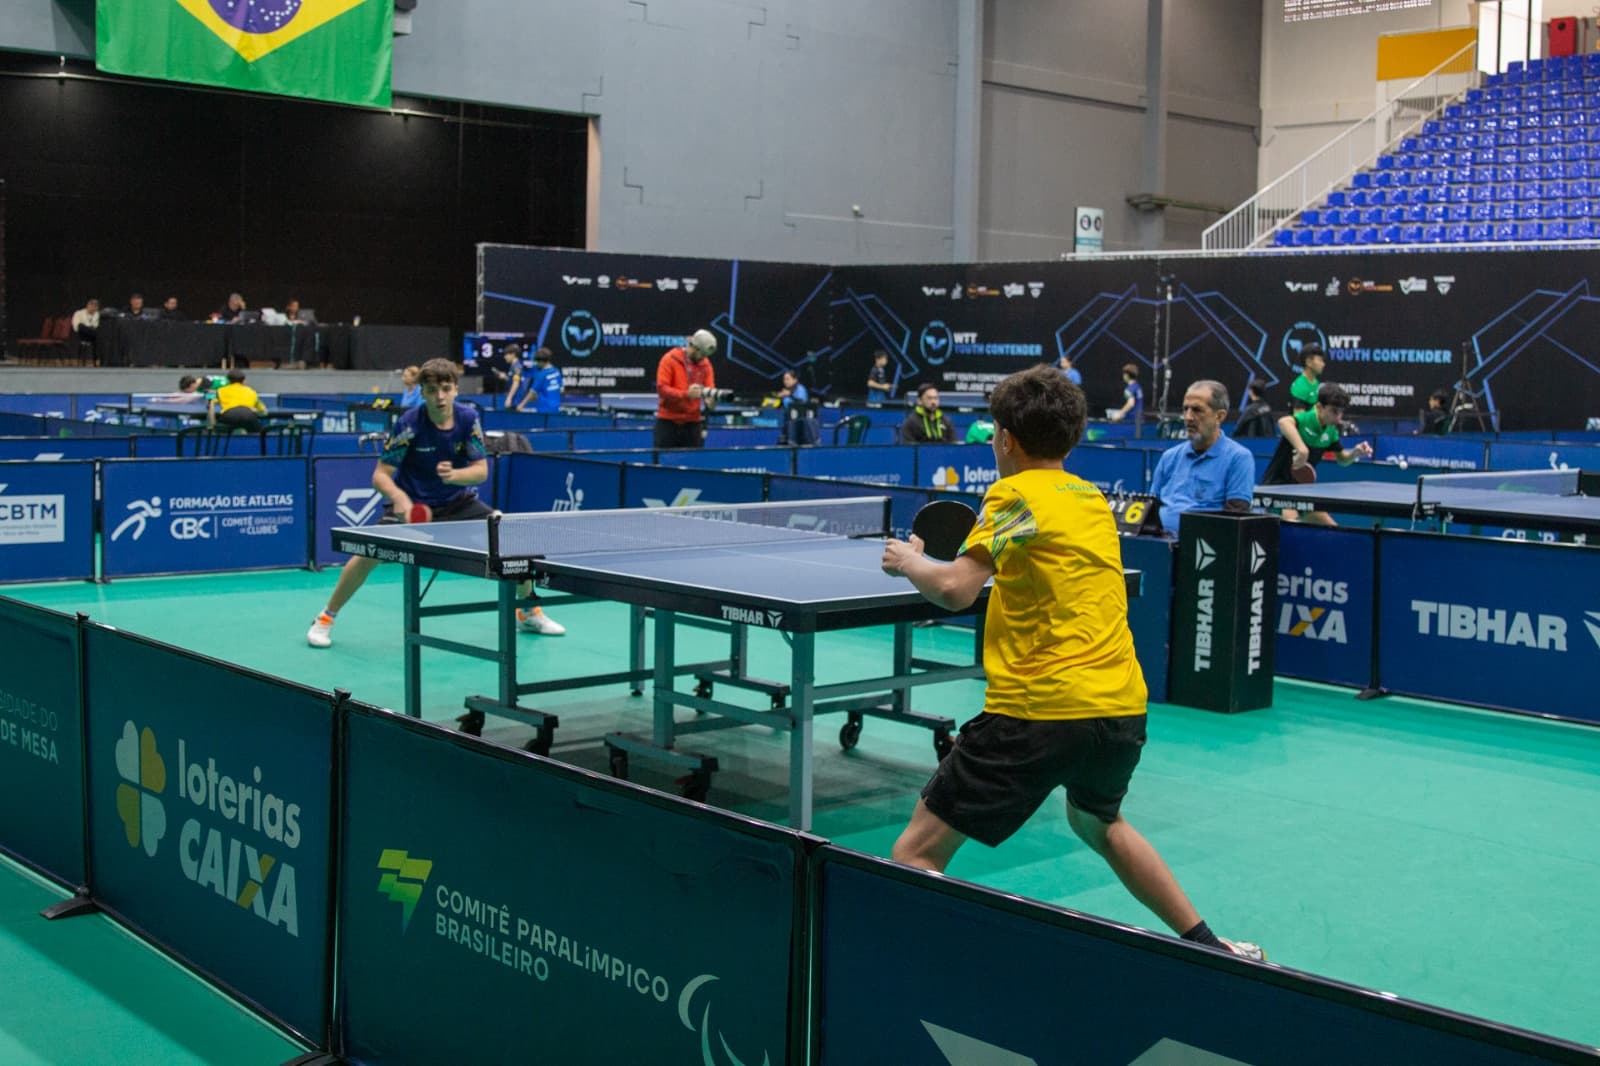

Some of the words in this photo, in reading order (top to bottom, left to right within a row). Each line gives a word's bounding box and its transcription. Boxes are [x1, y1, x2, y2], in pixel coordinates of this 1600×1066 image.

[602, 323, 629, 335] WTT
[953, 332, 978, 345] WTT
[603, 335, 637, 346] YOUTH
[639, 335, 690, 347] CONTEND
[954, 343, 985, 355] YOUTH
[985, 344, 1043, 357] CONTENDER
[1328, 335, 1361, 349] WTT
[1328, 349, 1370, 362] YOUTH
[1372, 349, 1452, 364] CONTENDER
[1361, 384, 1414, 396] CONTENDER
[964, 465, 998, 483] loter
[0, 502, 57, 520] CBTM
[169, 496, 231, 510] FORMAÇÃO
[232, 496, 246, 507] DE
[247, 494, 293, 506] ATLETAS
[1125, 502, 1145, 524] 6
[170, 515, 210, 540] CBC
[1277, 567, 1349, 604] erias
[721, 605, 764, 626] TIBHAR
[1194, 579, 1214, 672] TIBHAR
[1278, 603, 1347, 644] IXA
[1411, 600, 1567, 652] TIBHAR
[1248, 580, 1264, 675] TIBHAR
[0, 717, 17, 746] DE
[21, 729, 60, 765] MESA
[178, 739, 301, 849] loterias
[179, 818, 298, 937] CAIXA
[436, 885, 510, 935] COMITÊ
[435, 912, 549, 981] BRASILEIRO
